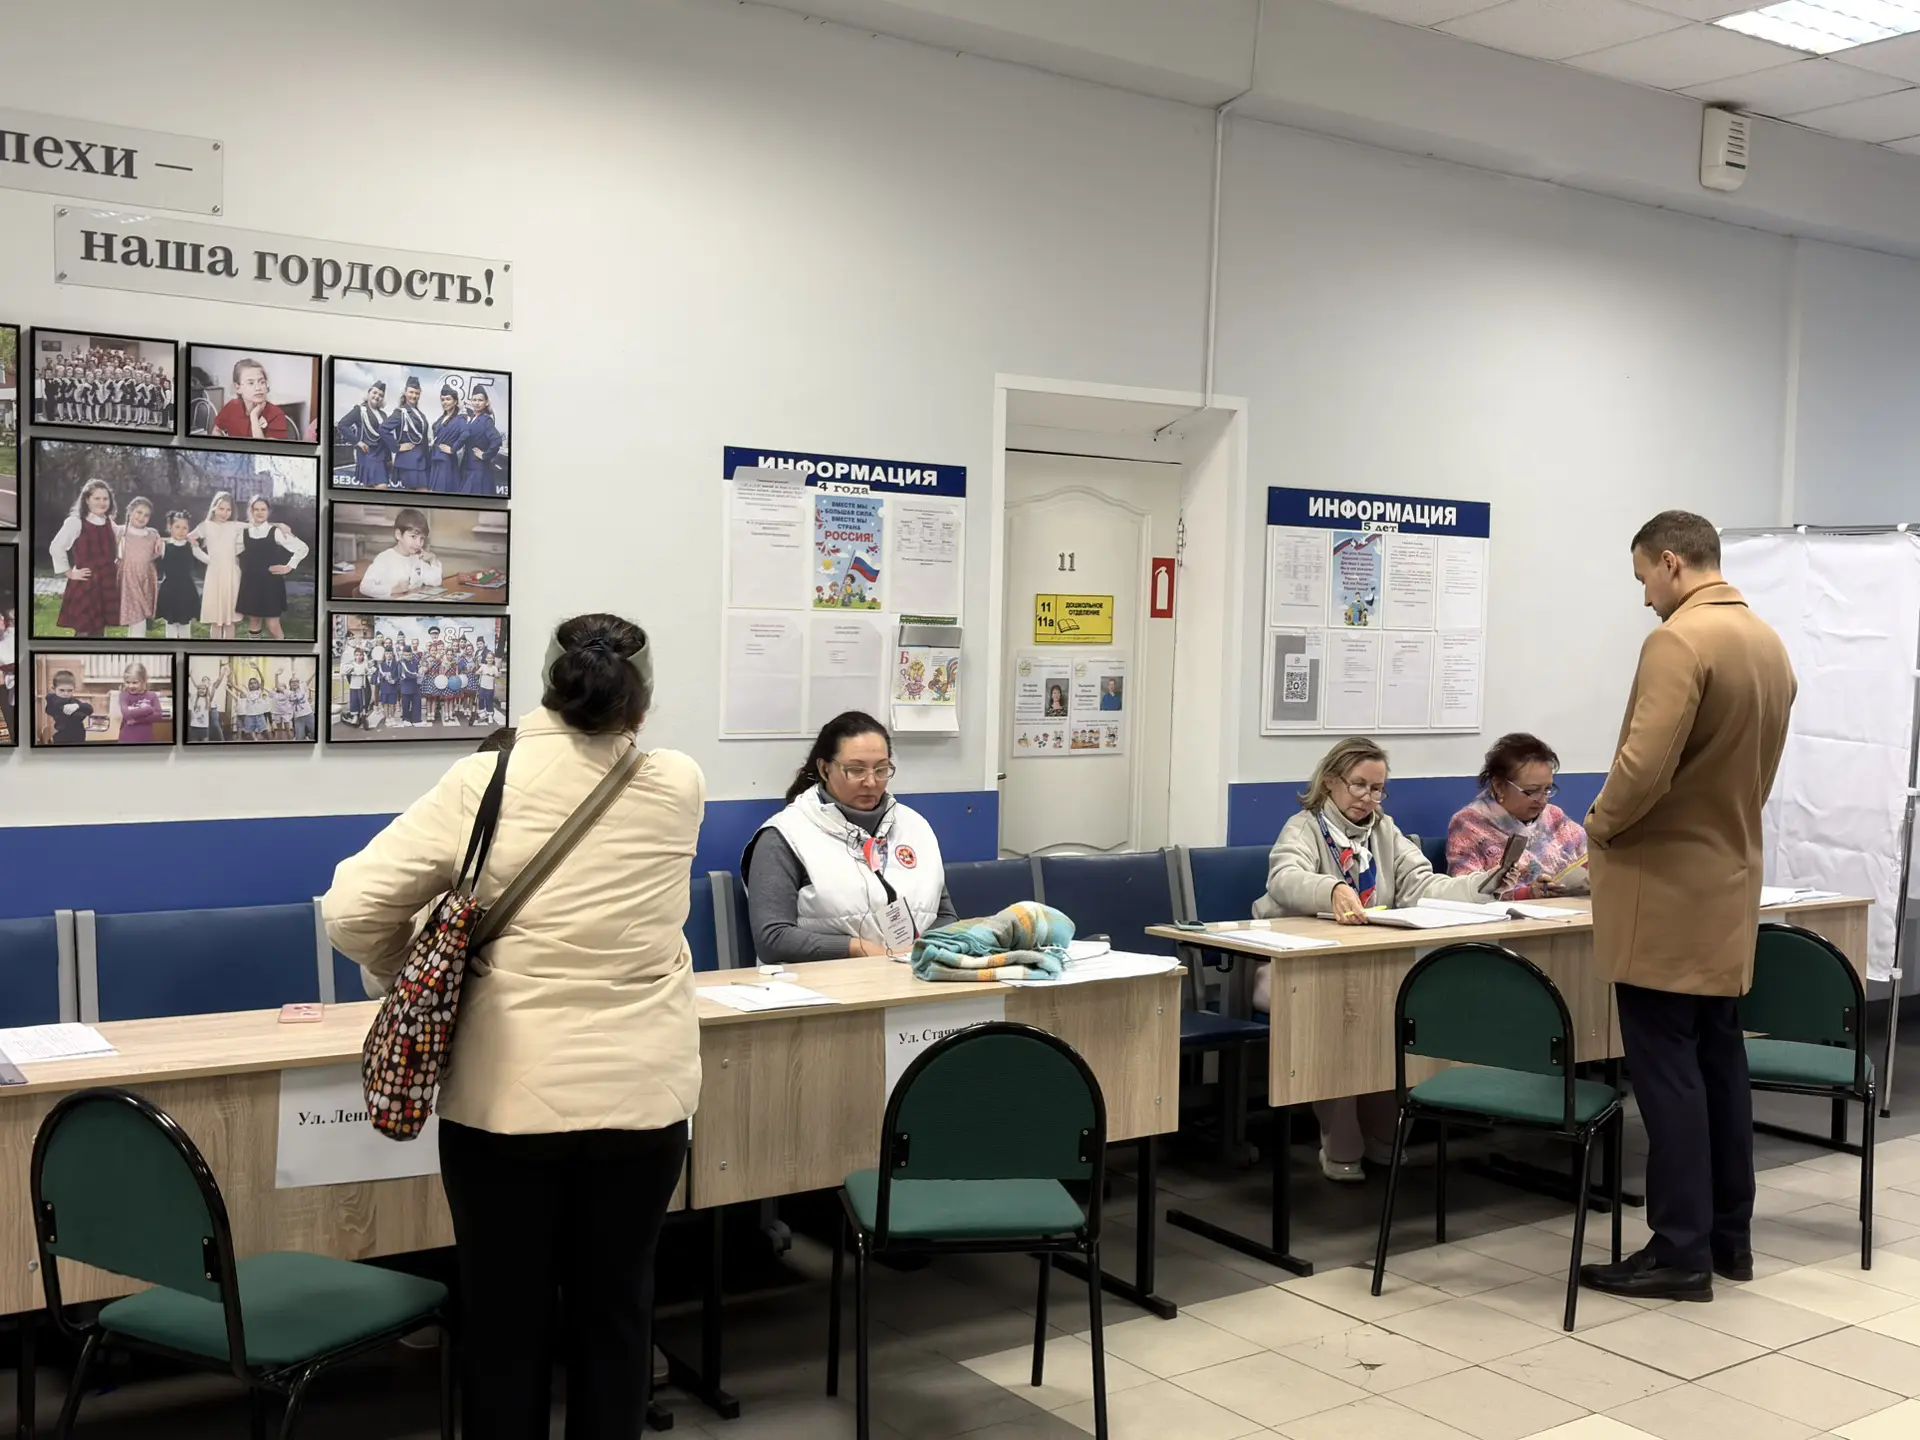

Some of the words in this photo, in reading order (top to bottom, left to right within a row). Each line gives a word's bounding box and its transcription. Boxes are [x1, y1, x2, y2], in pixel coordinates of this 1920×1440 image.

[0, 130, 138, 179] пехи
[80, 229, 239, 279] наша
[254, 250, 495, 306] гордость!
[758, 456, 938, 486] ИНФОРМАЦИЯ
[819, 482, 828, 492] 4
[834, 484, 869, 495] года
[1309, 497, 1457, 528] ИНФОРМАЦИЯ
[1363, 522, 1371, 532] 5
[825, 530, 874, 542] РОССИЯ!
[1058, 552, 1076, 571] 11
[1041, 601, 1051, 612] 11
[1037, 616, 1054, 627] 11а
[899, 1032, 919, 1045] Ул.
[922, 1028, 959, 1041] Стач
[298, 1112, 326, 1126] Ул.
